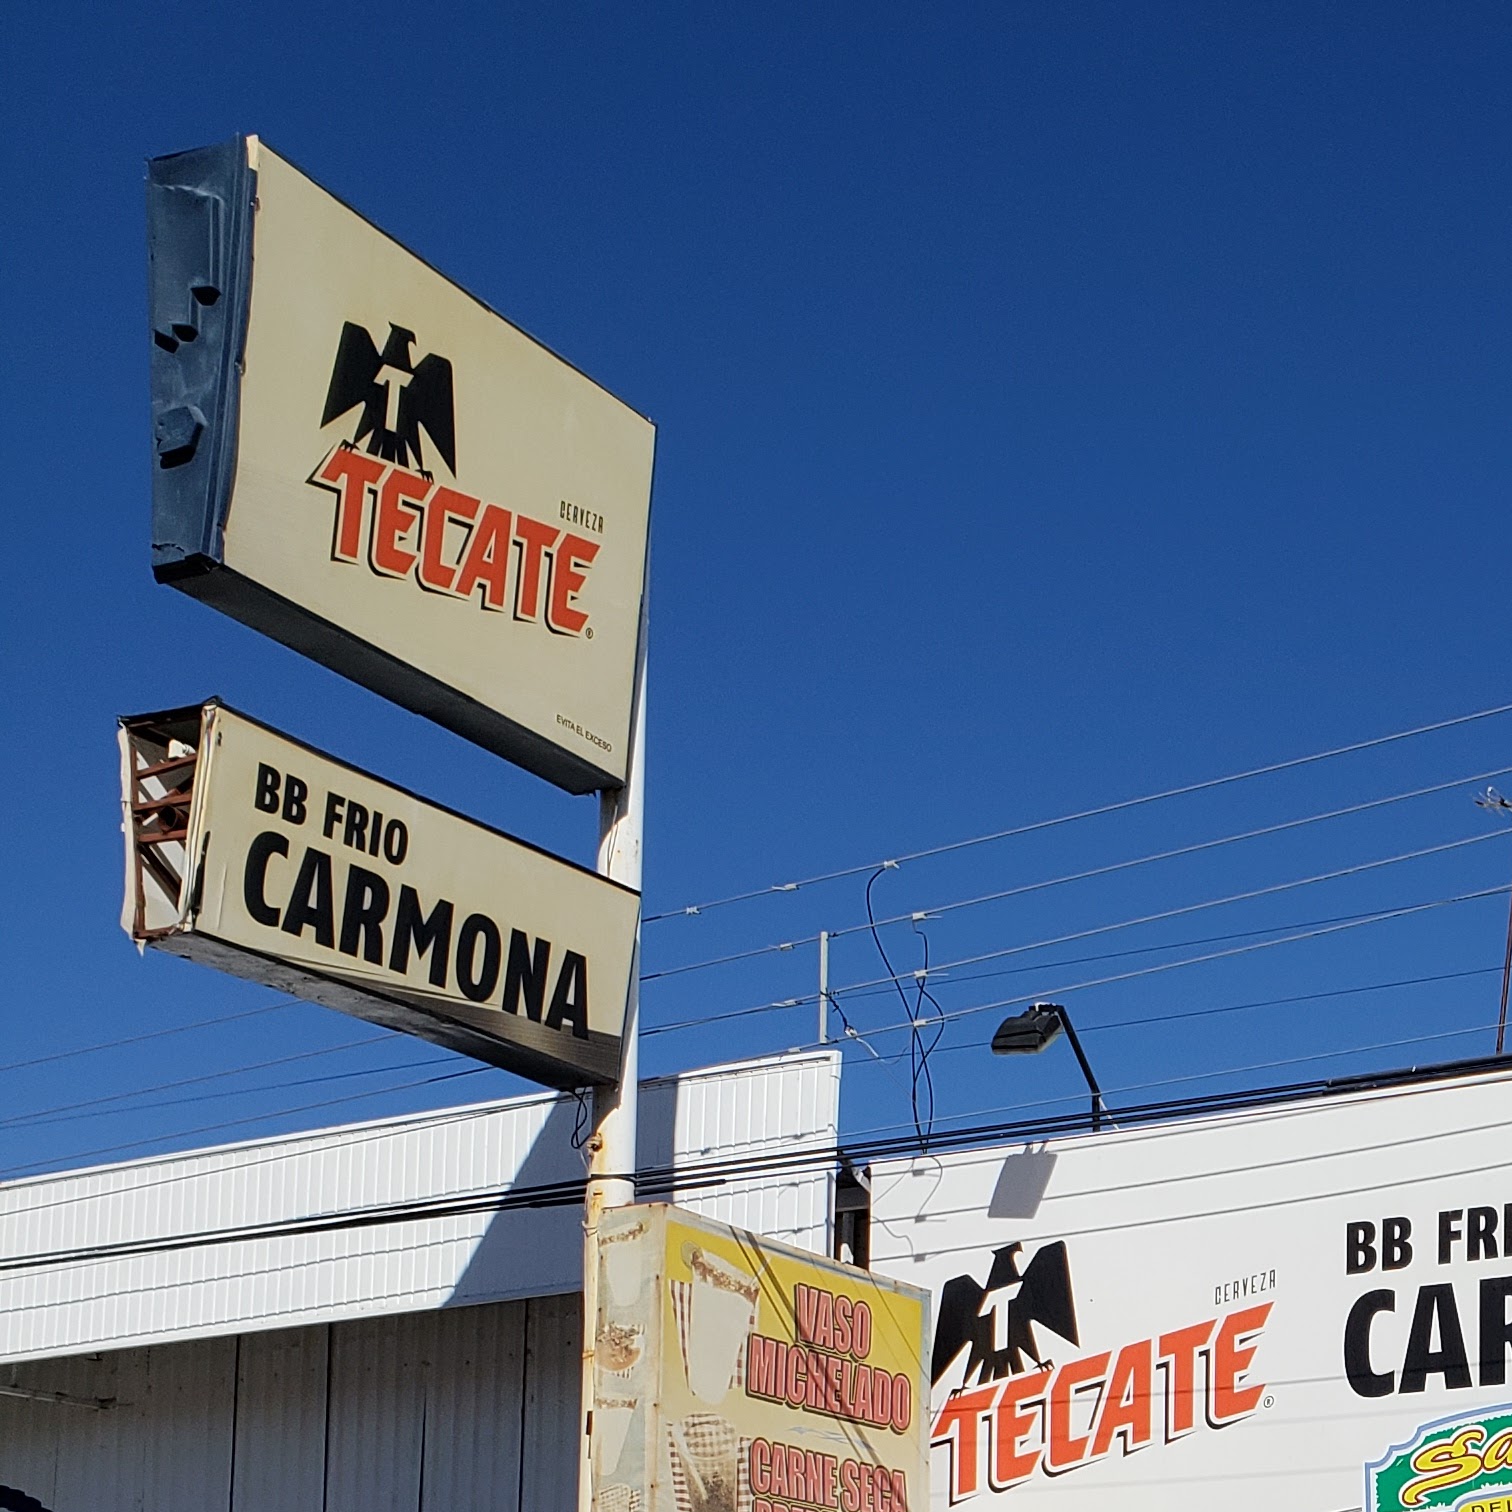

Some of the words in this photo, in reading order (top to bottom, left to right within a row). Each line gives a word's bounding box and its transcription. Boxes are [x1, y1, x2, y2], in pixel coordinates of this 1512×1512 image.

[305, 445, 602, 638] TECATE
[560, 500, 604, 535] CERVEZA
[556, 714, 576, 732] EVITA
[576, 724, 585, 737] EL
[585, 729, 612, 753] EXCESO
[254, 762, 307, 824] BB
[323, 791, 408, 866] FRIO
[243, 831, 589, 1041] CARMONA
[1346, 1216, 1413, 1275] BB
[796, 1283, 872, 1362] VASO
[1215, 1269, 1276, 1305] CERVEZA
[746, 1332, 913, 1435] MICHELADO
[930, 1302, 1275, 1508] TECATE
[749, 1436, 839, 1512] CARNE
